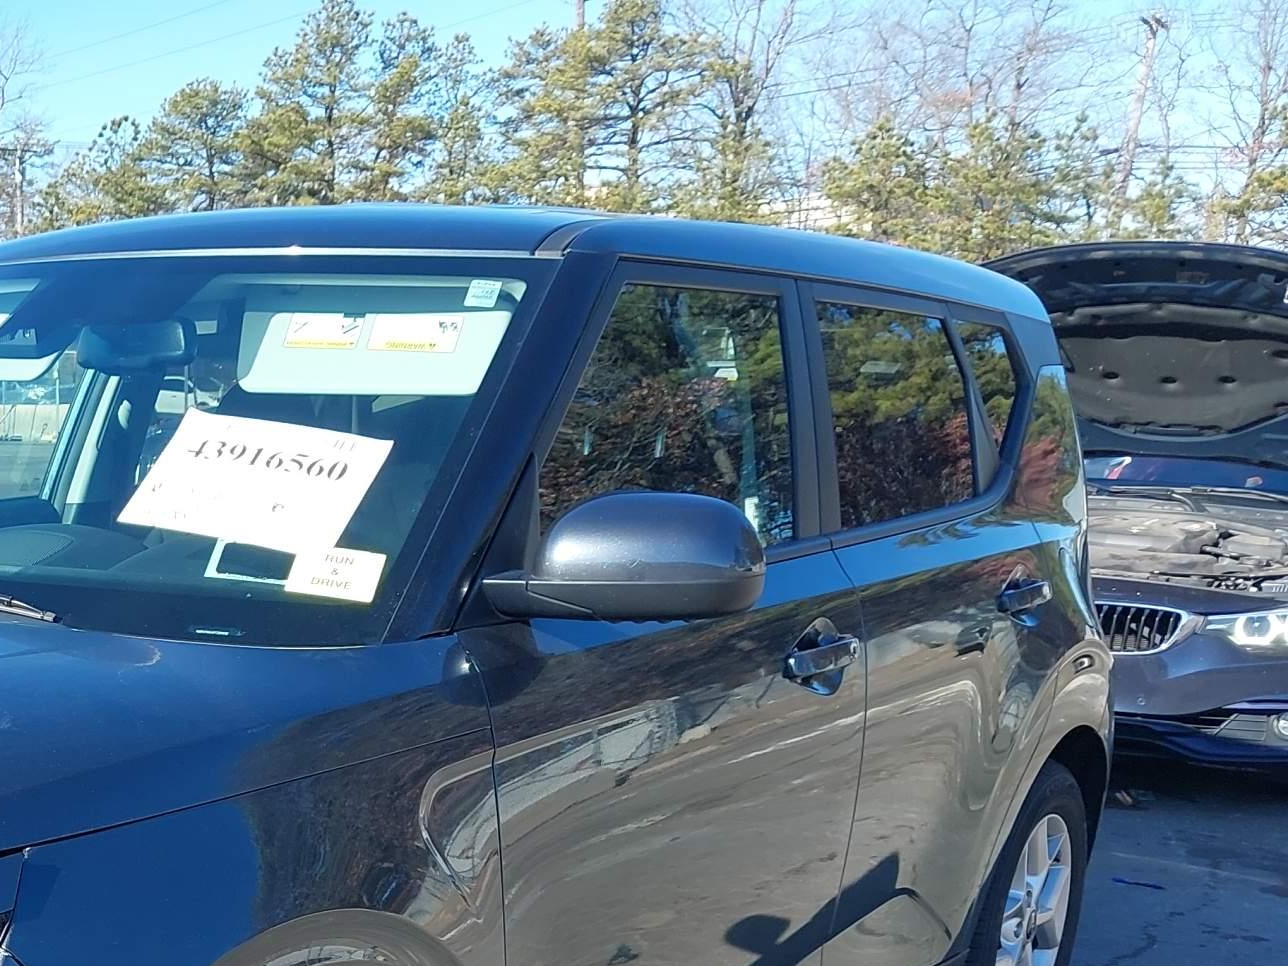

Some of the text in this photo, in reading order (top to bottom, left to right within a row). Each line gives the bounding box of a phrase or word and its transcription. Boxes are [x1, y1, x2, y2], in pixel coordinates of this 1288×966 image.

[187, 439, 350, 481] 43916560
[325, 554, 355, 565] RUN
[331, 568, 339, 576] &
[311, 576, 352, 590] DRIVE
